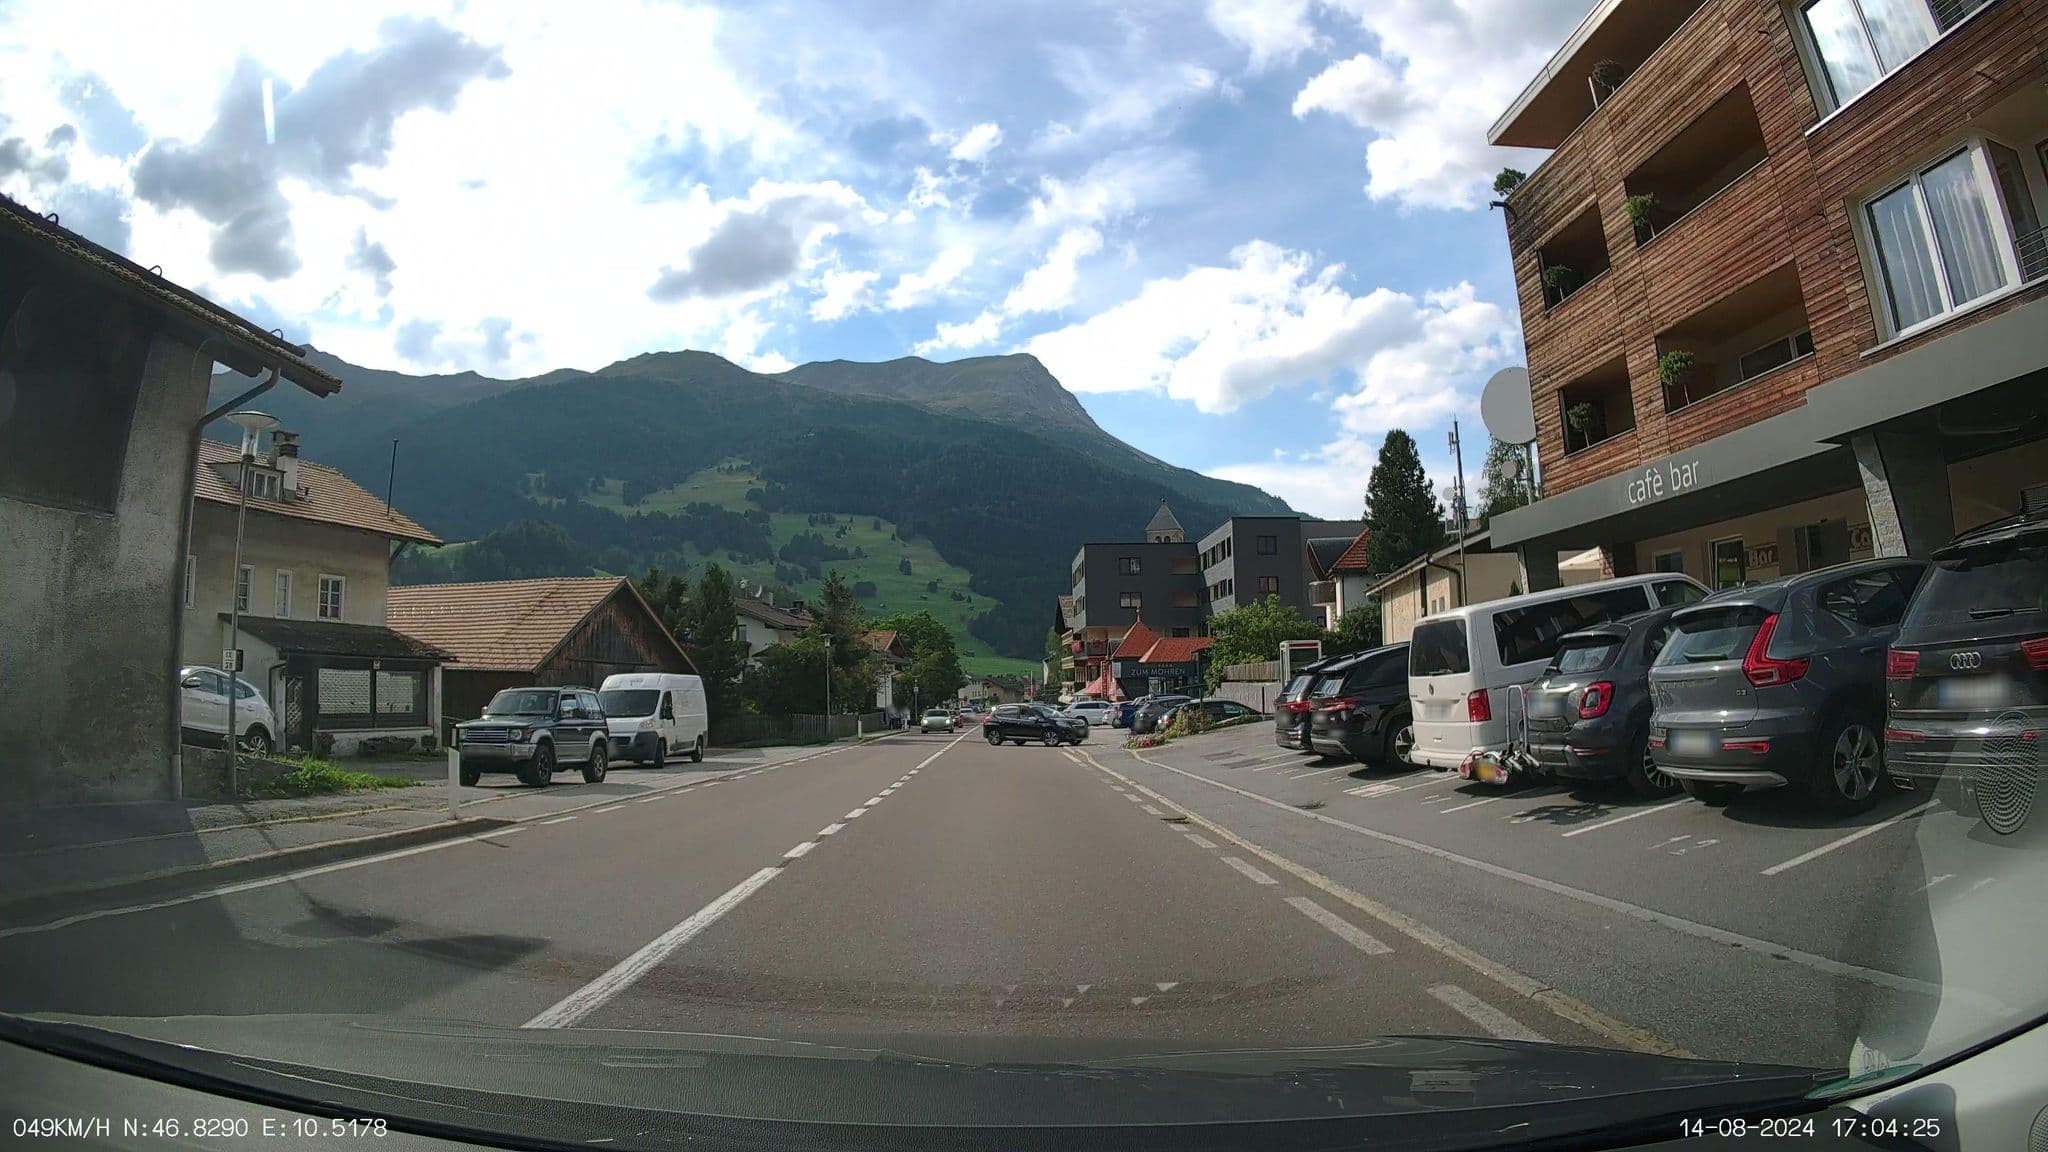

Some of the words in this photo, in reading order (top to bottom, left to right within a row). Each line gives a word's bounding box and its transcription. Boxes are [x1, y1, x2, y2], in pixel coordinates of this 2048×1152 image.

[1628, 467, 1664, 504] cafè
[1669, 460, 1699, 491] bar
[1130, 668, 1148, 676] ZUM
